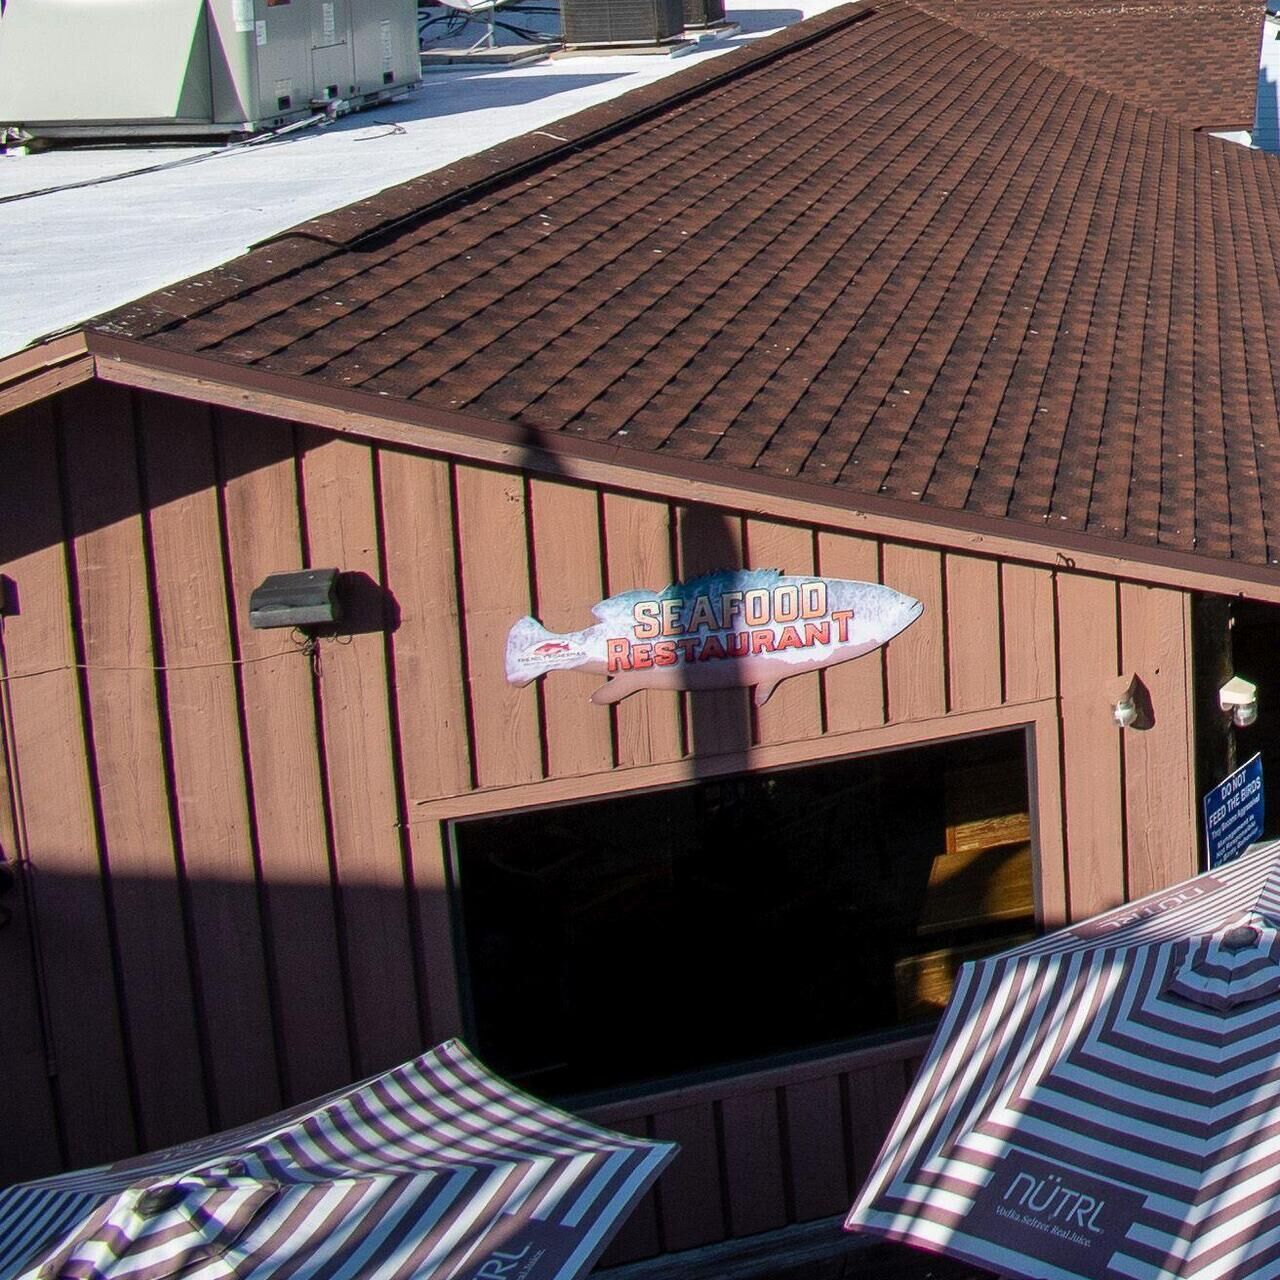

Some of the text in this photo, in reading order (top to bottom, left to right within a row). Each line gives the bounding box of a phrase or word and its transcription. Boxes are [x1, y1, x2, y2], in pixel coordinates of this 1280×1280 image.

[632, 580, 829, 639] SEAFOOD
[605, 609, 855, 673] RESTAURANT
[1208, 776, 1261, 829] FEED THE BIRDS
[1221, 769, 1247, 800] DO NOT
[996, 1204, 1021, 1223] Vodka.
[1021, 1214, 1050, 1233] Seltzer.
[1050, 1224, 1070, 1241] Real
[1003, 1172, 1104, 1233] NÜTRL
